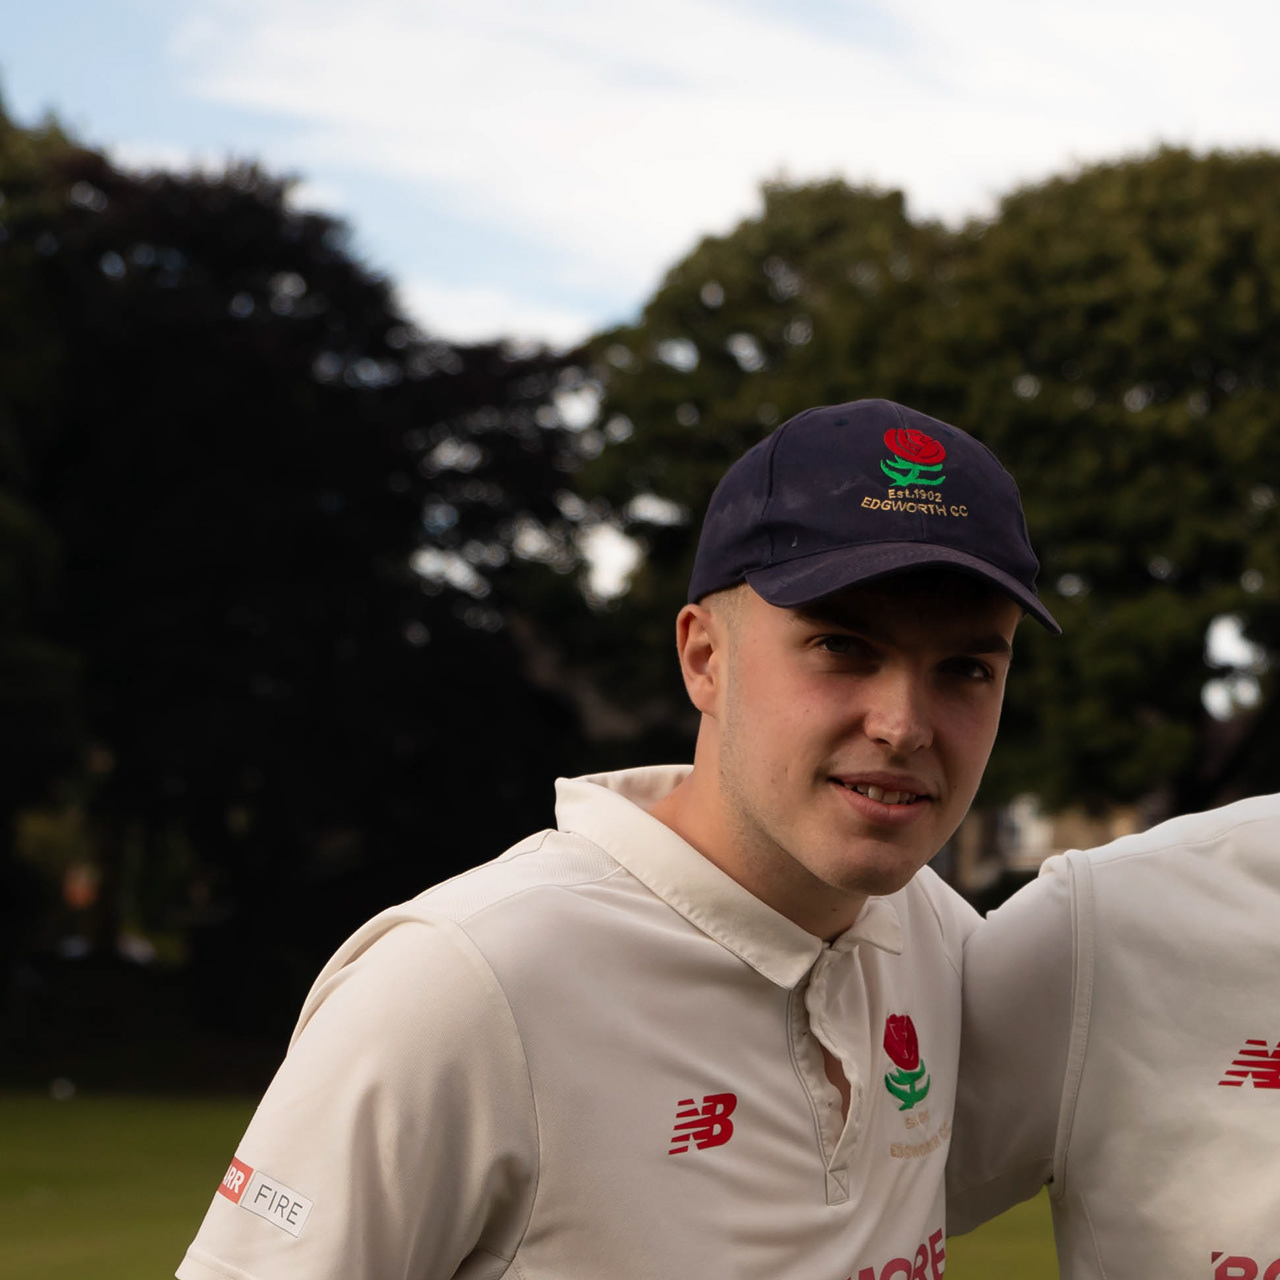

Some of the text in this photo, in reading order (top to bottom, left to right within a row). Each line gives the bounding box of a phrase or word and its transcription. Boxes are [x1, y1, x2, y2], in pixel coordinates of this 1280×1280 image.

[861, 496, 969, 517] EDGWORTH CC
[222, 1164, 303, 1225] RR FIRE
